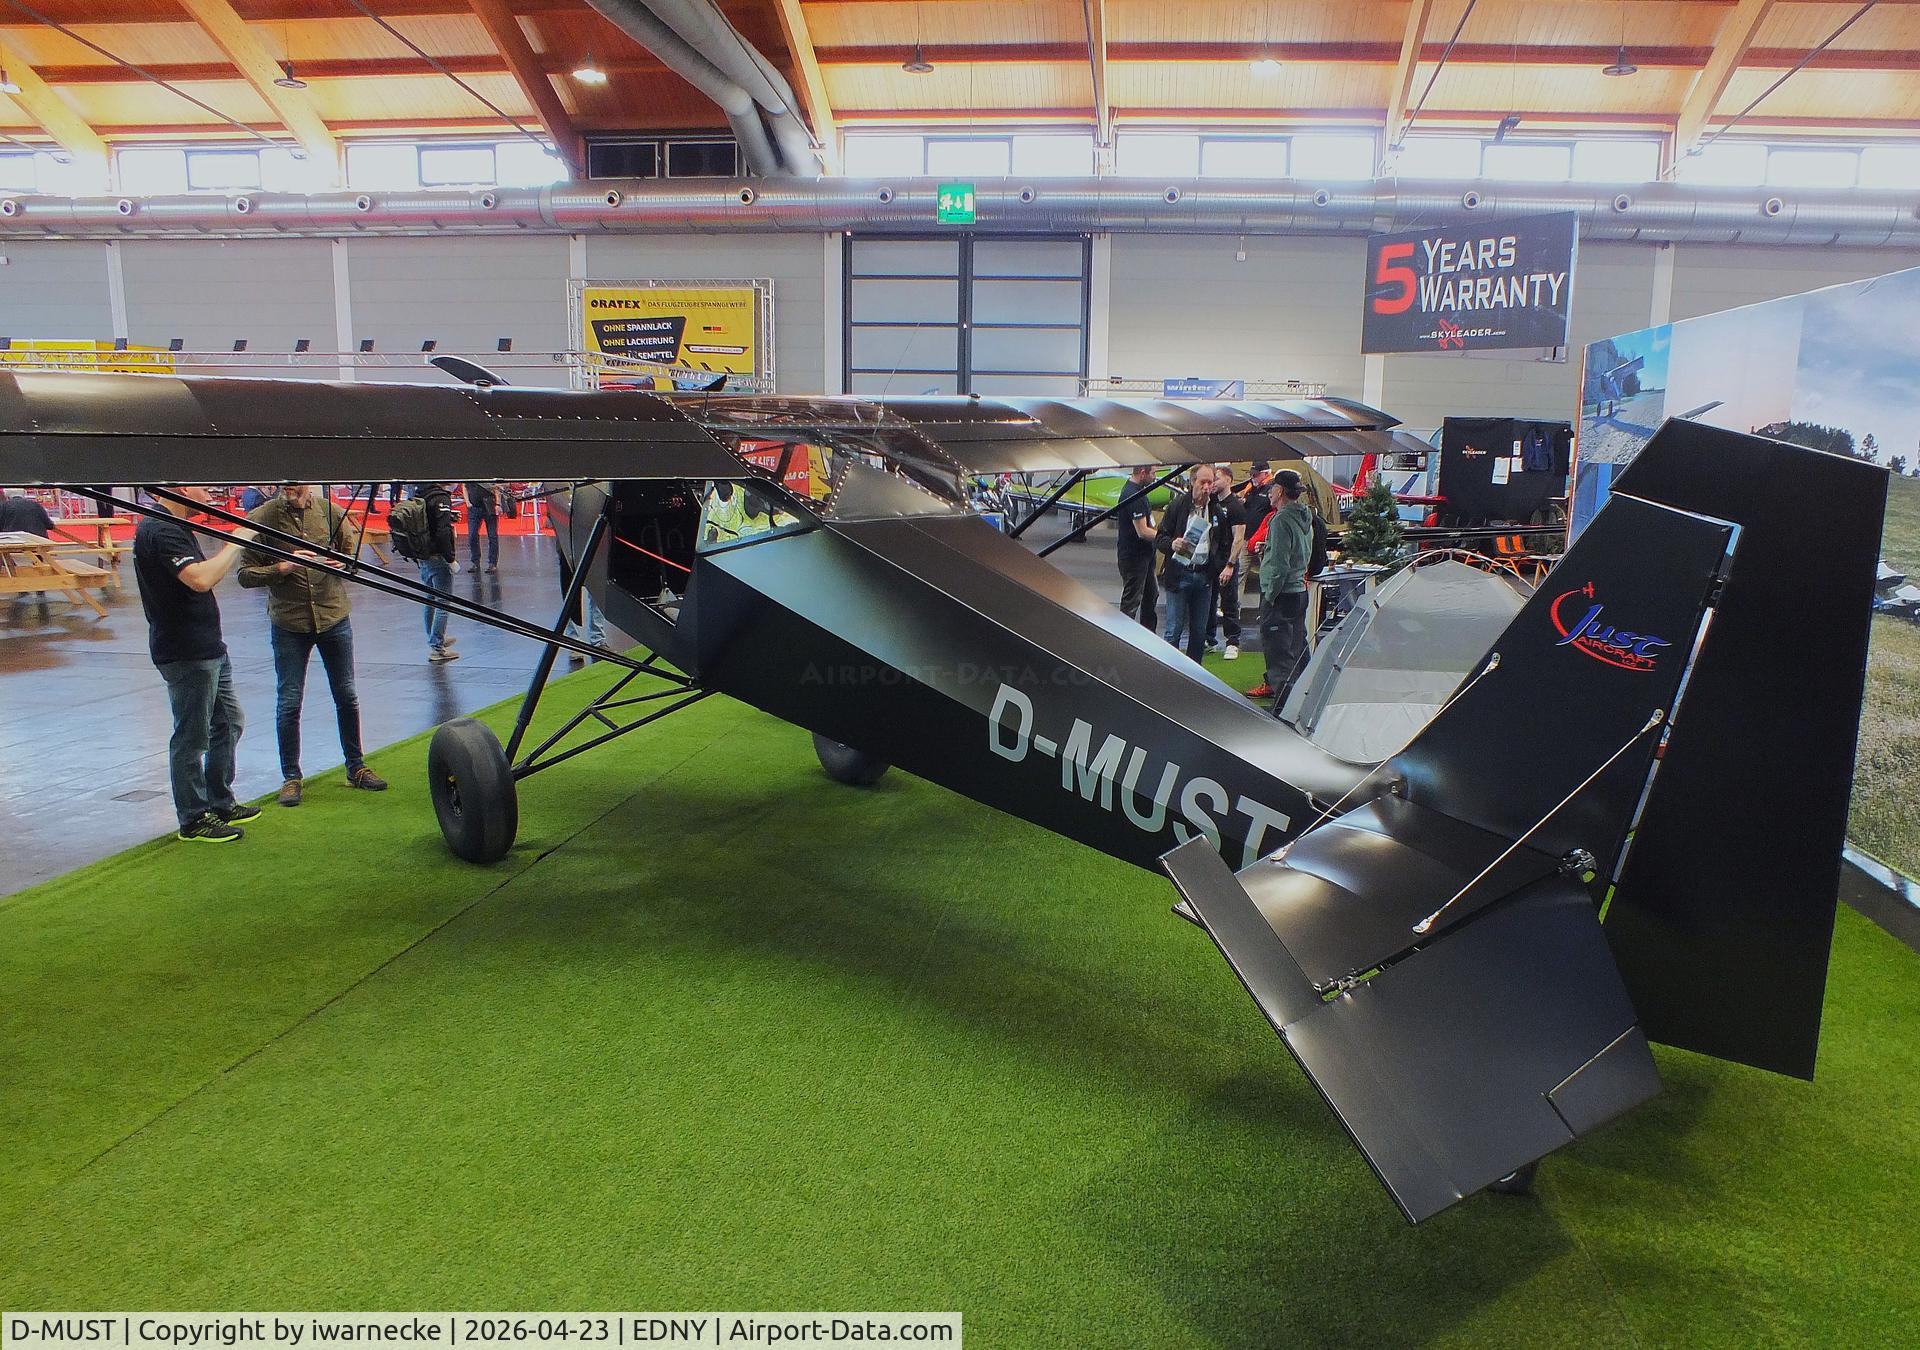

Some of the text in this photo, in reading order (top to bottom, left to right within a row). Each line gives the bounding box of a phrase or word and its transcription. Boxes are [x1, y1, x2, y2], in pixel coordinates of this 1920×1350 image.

[1373, 236, 1517, 315] 5 YEARS
[590, 299, 641, 309] ORATEX
[1419, 272, 1566, 313] WARRANTY
[603, 322, 673, 333] OHNE SPANNLACK
[603, 337, 675, 347] OHNE LACKIERUNG
[989, 682, 1291, 869] D-MUST
